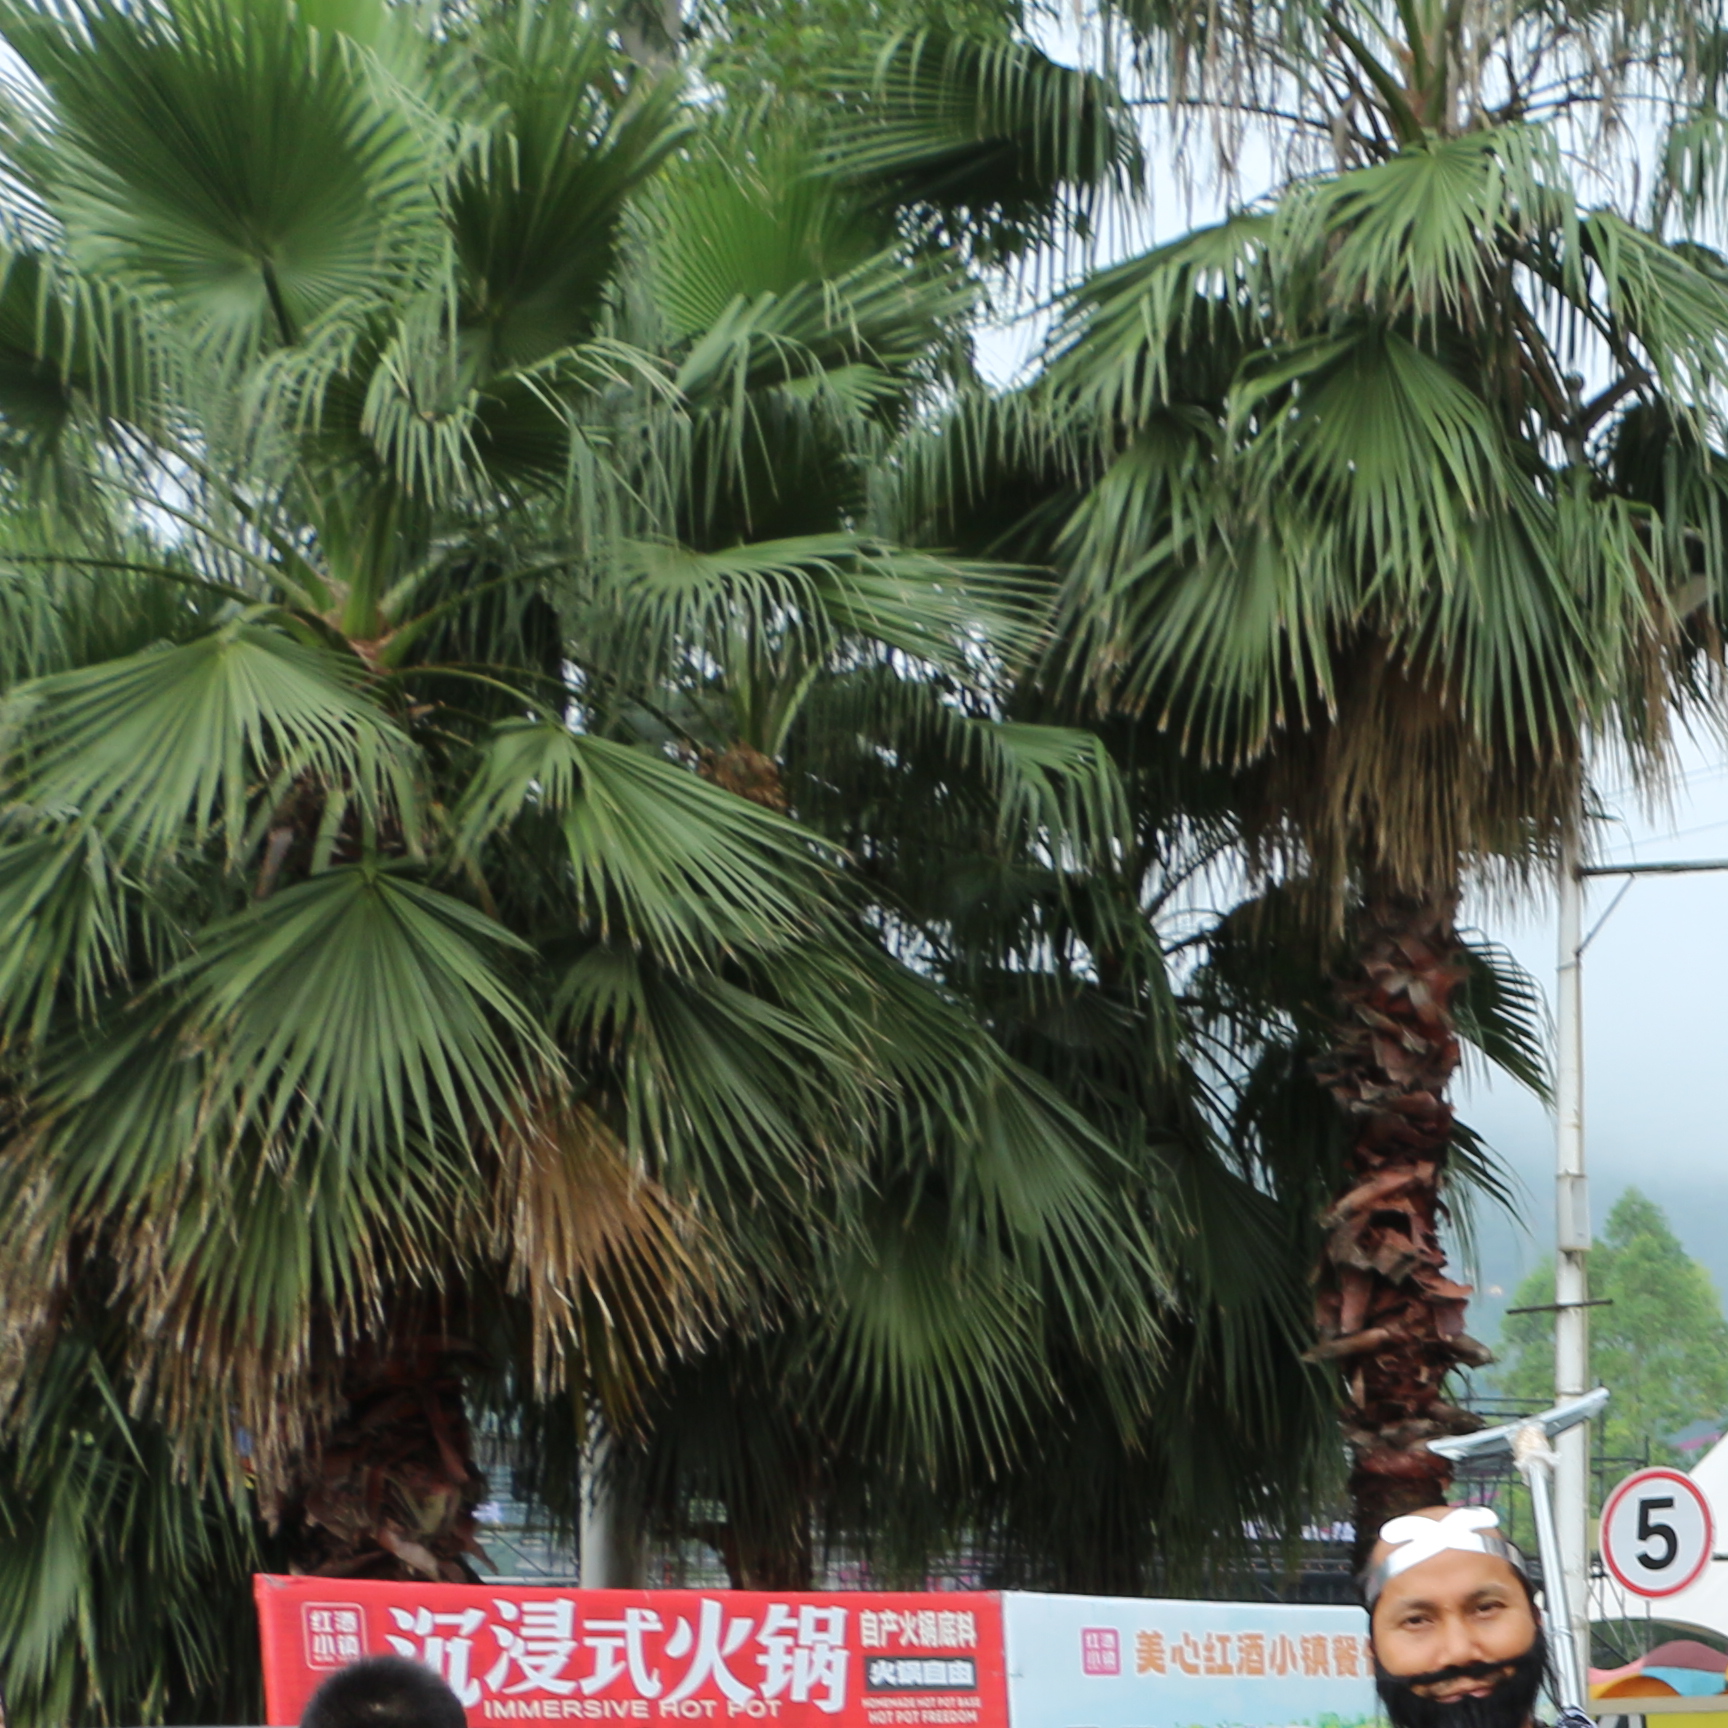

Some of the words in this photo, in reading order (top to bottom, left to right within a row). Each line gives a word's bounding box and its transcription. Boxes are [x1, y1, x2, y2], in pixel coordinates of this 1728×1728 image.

[1636, 1497, 1678, 1570] 5
[859, 1608, 978, 1648] 自产火锅底料
[385, 1598, 848, 1714] 沉浸式火锅
[484, 1699, 650, 1719] IMMERSIVE
[659, 1699, 717, 1718] HOT
[727, 1699, 782, 1718] POT
[868, 1710, 896, 1725] HOT
[895, 1710, 921, 1724] POT
[921, 1710, 979, 1724] FREEDOM
